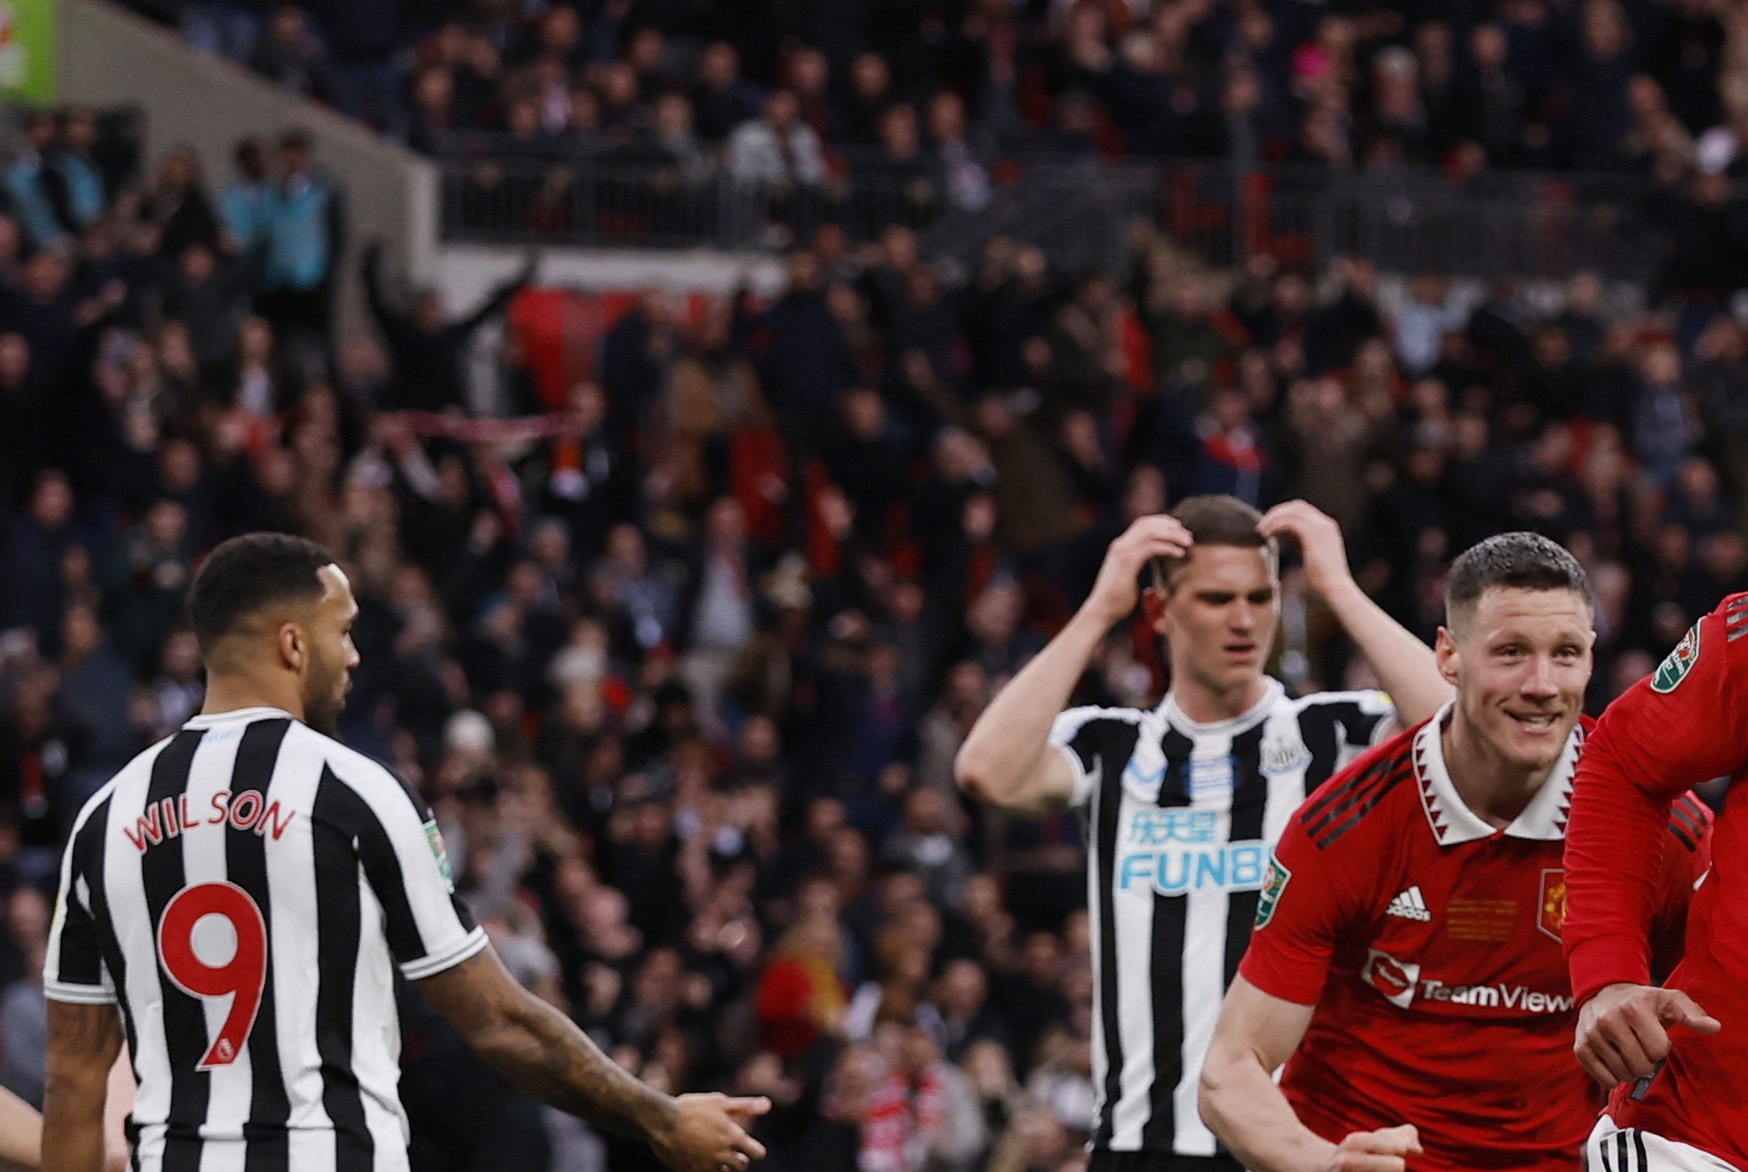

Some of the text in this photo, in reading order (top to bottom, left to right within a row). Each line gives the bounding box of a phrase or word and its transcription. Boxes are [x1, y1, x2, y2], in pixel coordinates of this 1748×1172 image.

[123, 789, 297, 854] WILSON
[1119, 846, 1275, 890] FUN8
[159, 881, 268, 1072] 9
[1421, 979, 1575, 1014] TeamView
